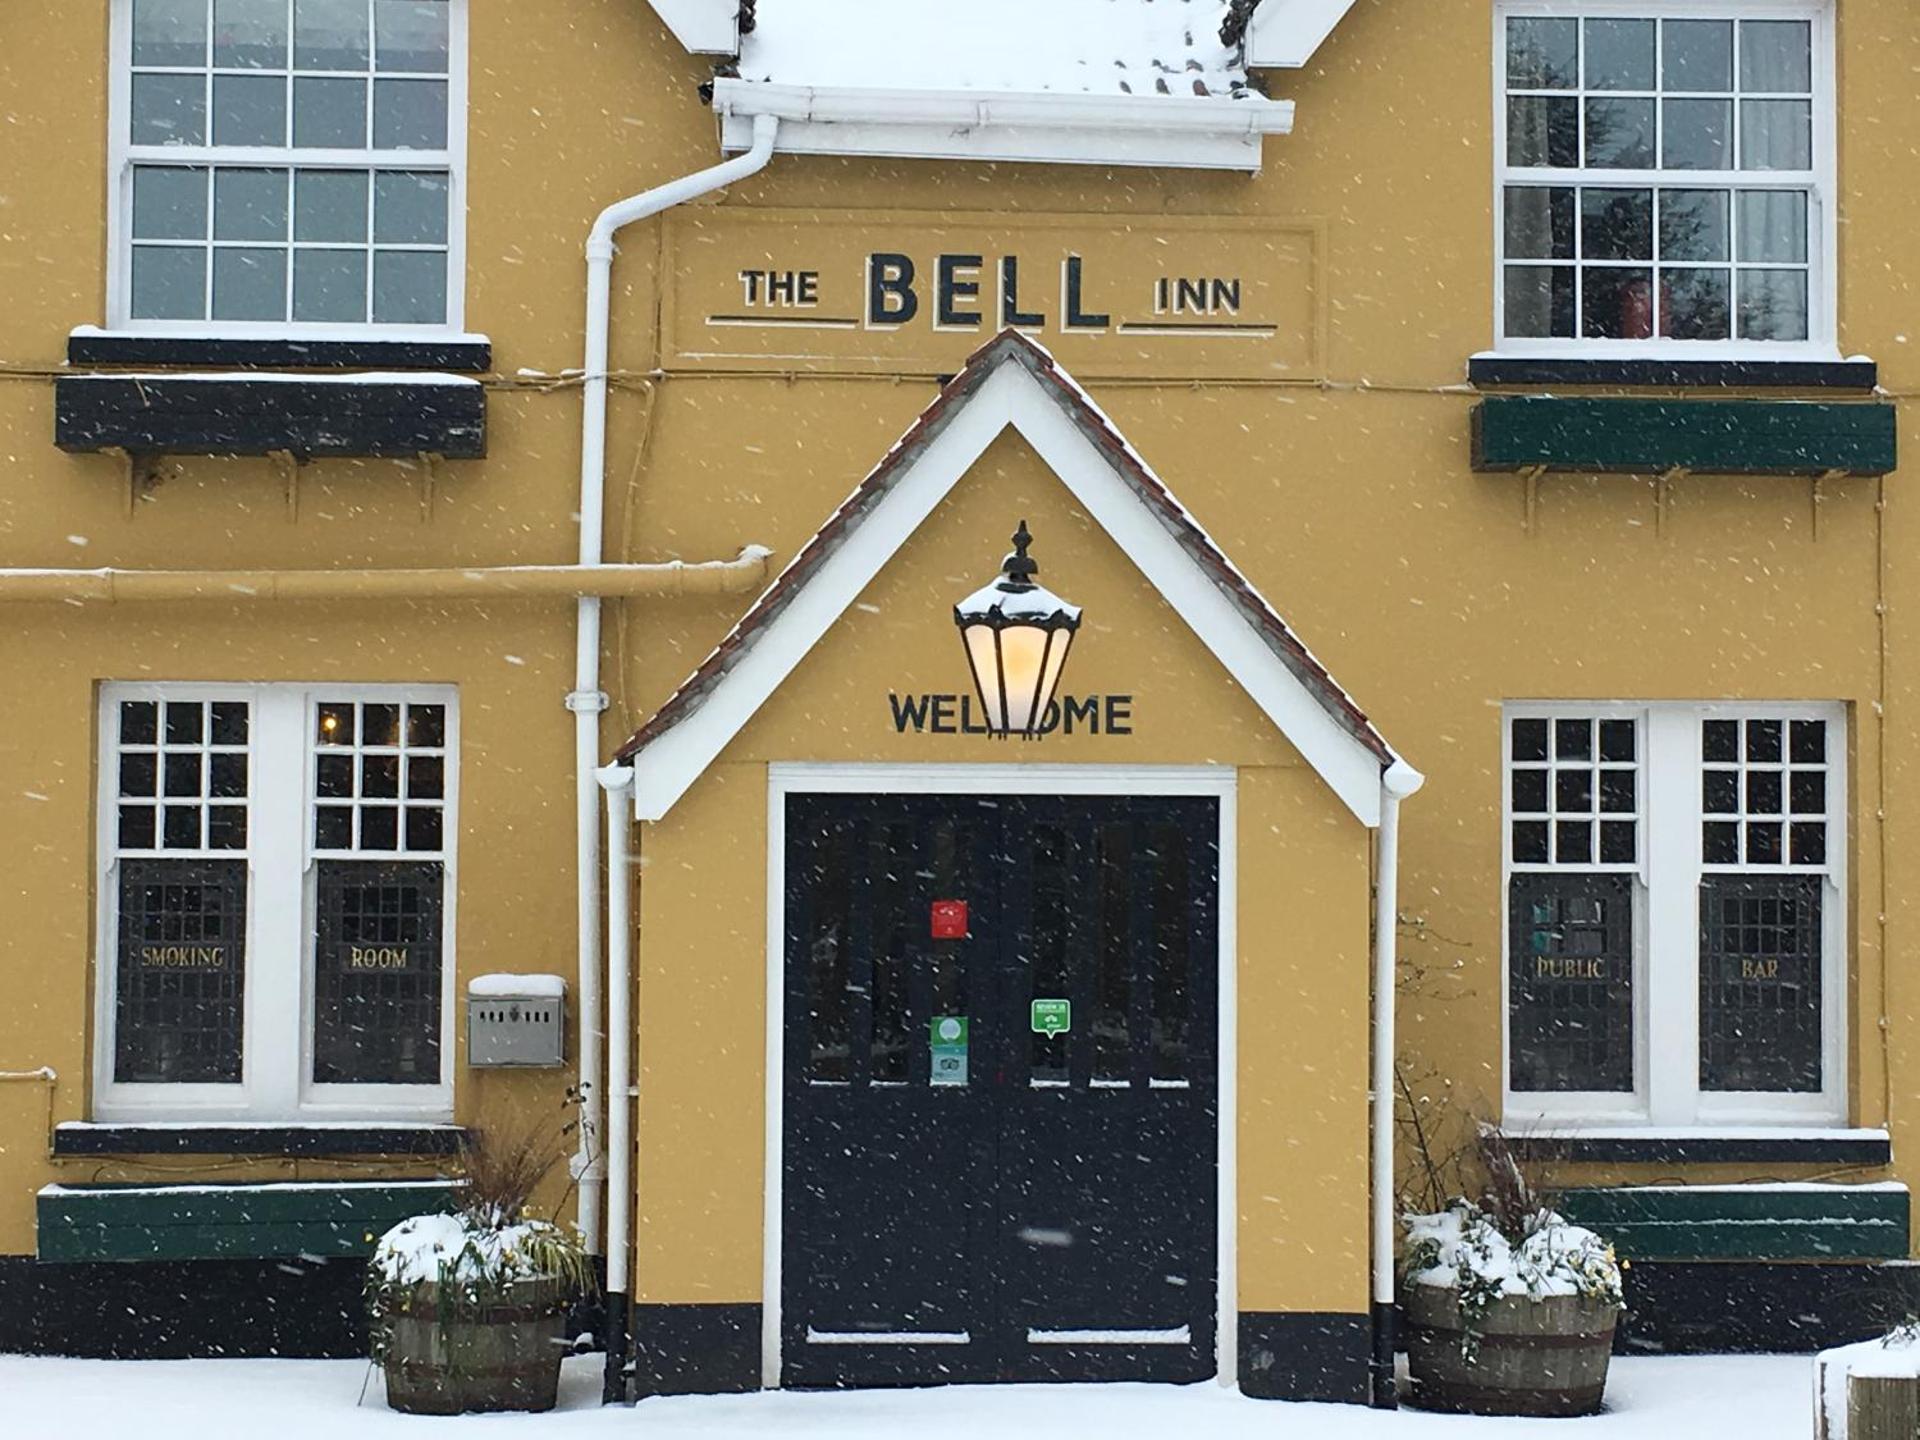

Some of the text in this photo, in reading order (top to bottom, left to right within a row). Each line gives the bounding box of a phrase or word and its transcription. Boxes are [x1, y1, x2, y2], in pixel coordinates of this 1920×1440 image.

[739, 253, 1241, 334] THE BELL INN
[889, 694, 1132, 735] WELME
[141, 946, 408, 969] SMOKING ROOM
[1537, 956, 1779, 979] PUBLIC BAR
